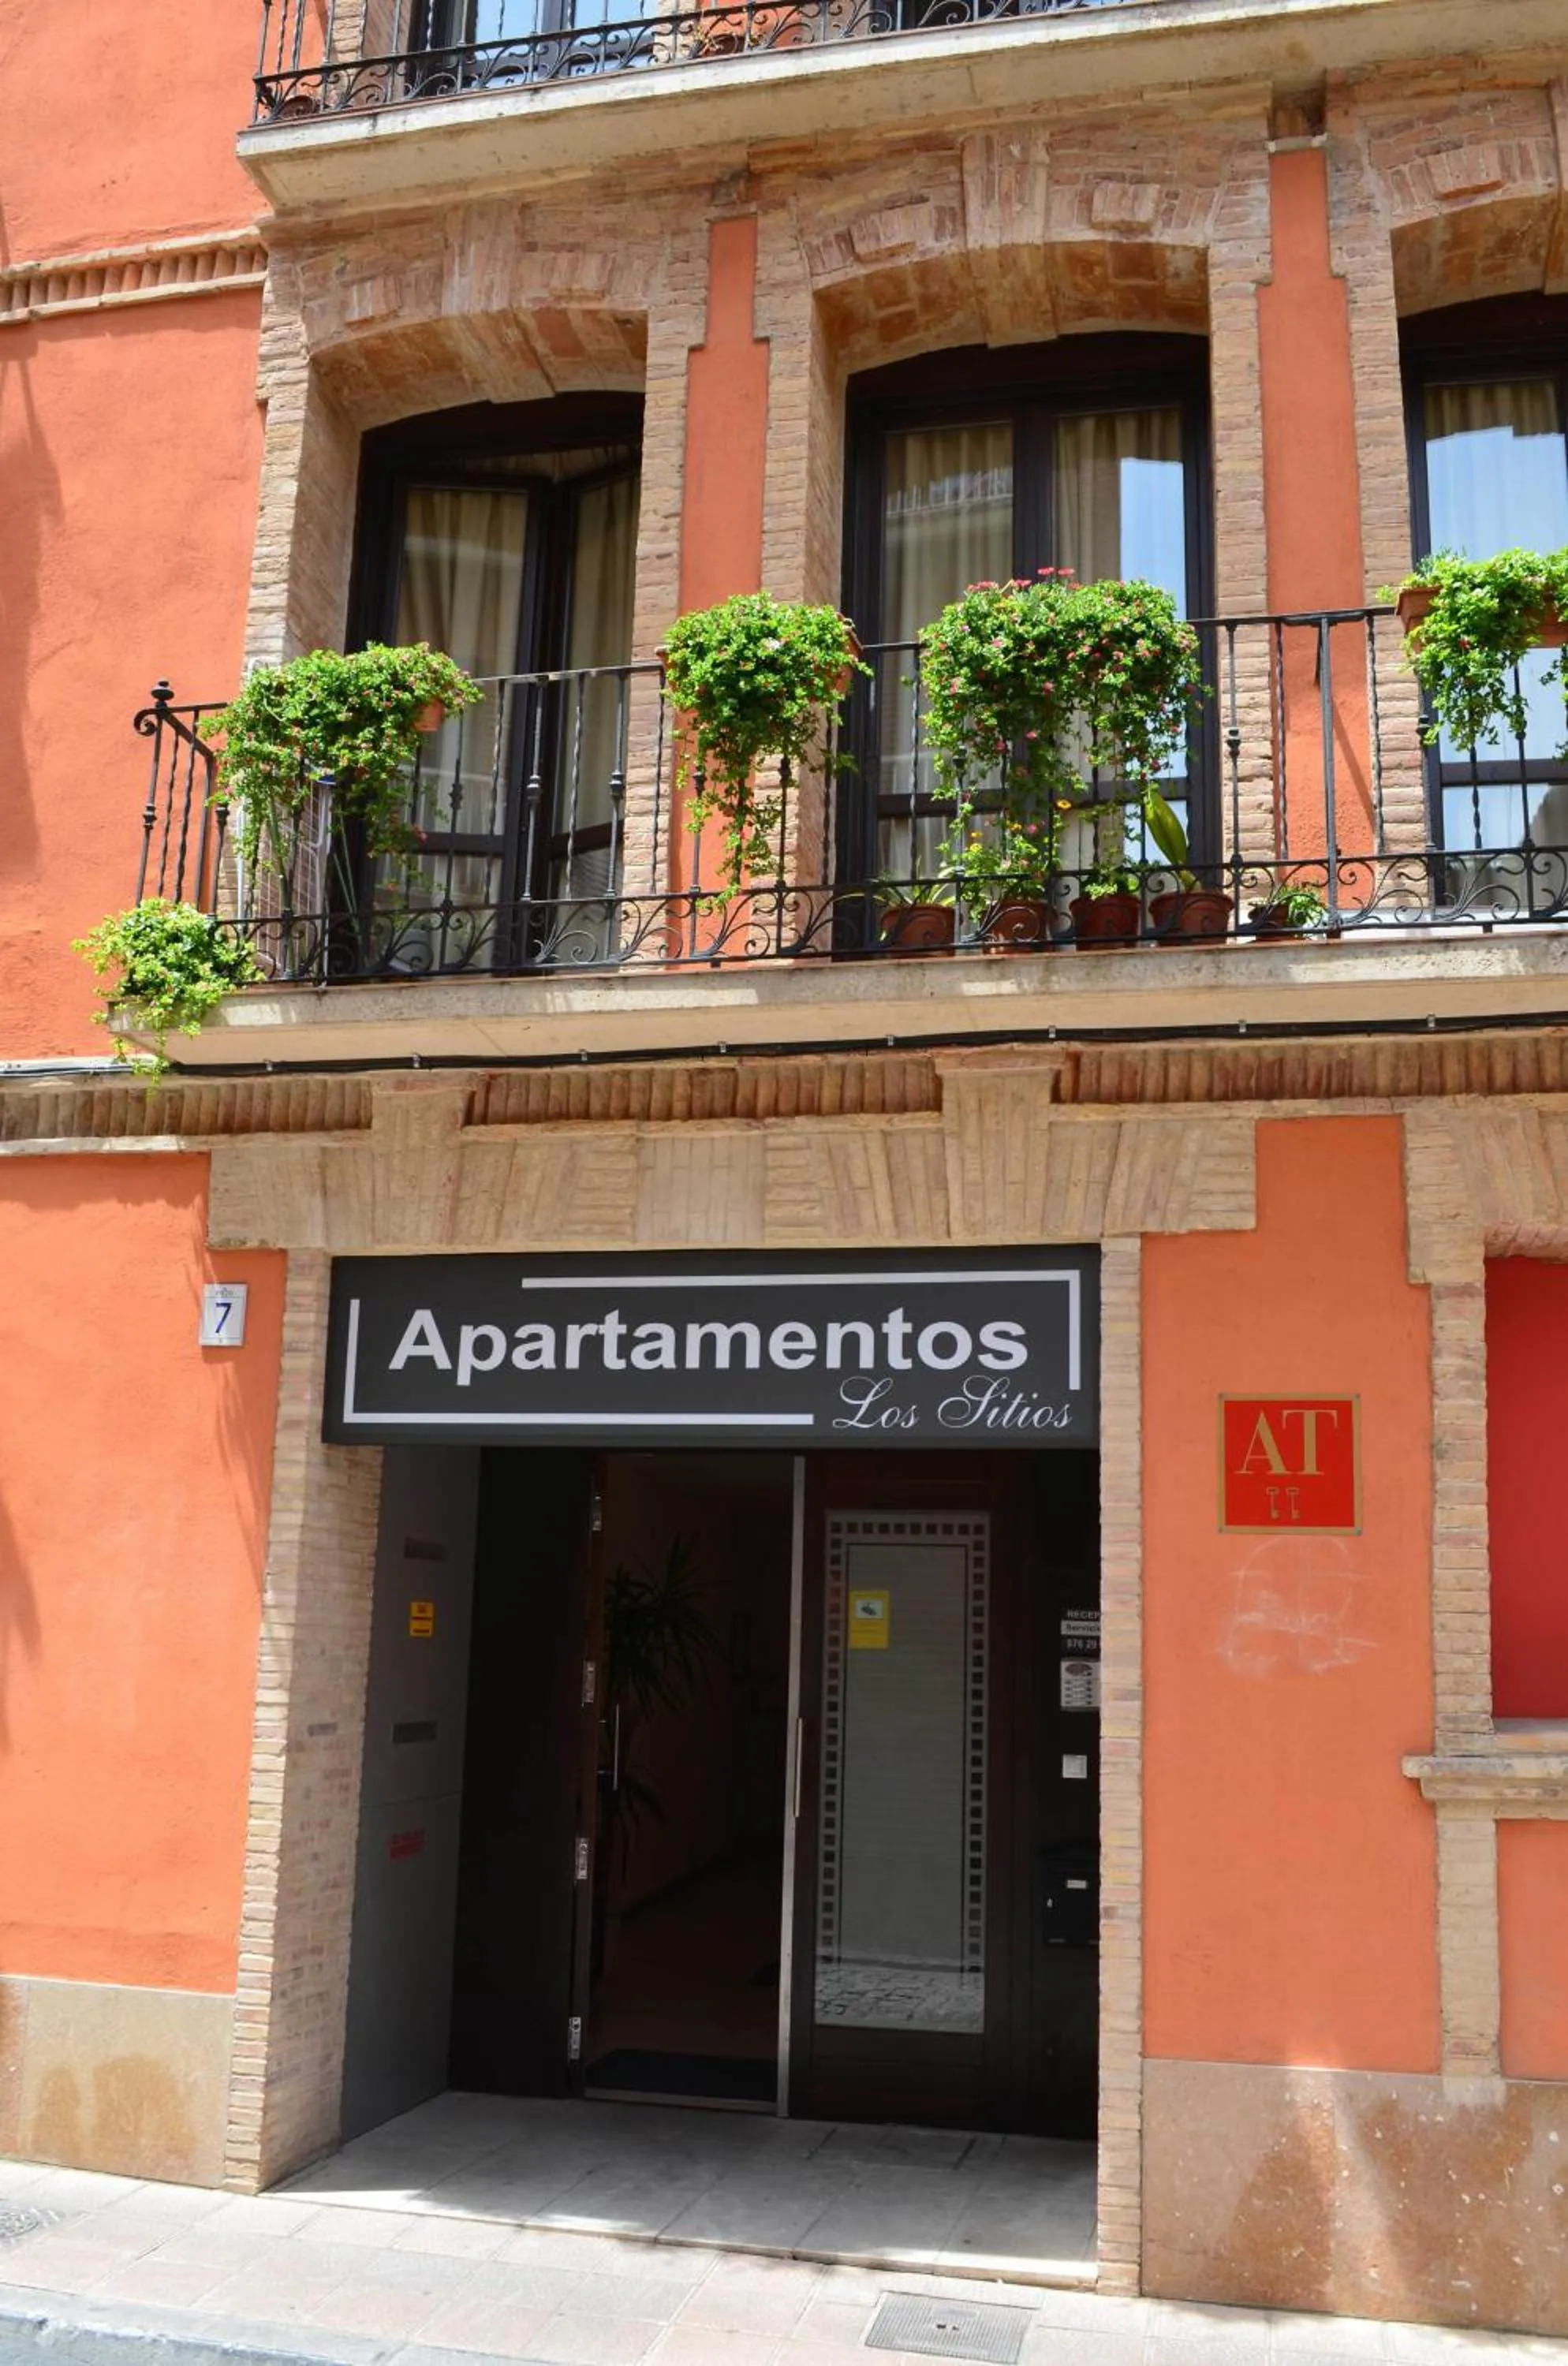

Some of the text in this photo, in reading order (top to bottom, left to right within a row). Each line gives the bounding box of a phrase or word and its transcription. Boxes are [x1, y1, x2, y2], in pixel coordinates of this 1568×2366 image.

[215, 1302, 233, 1334] 7
[388, 1306, 1029, 1386] Apartamentos
[832, 1375, 1071, 1428] Los Sitios
[1234, 1409, 1338, 1476] AT
